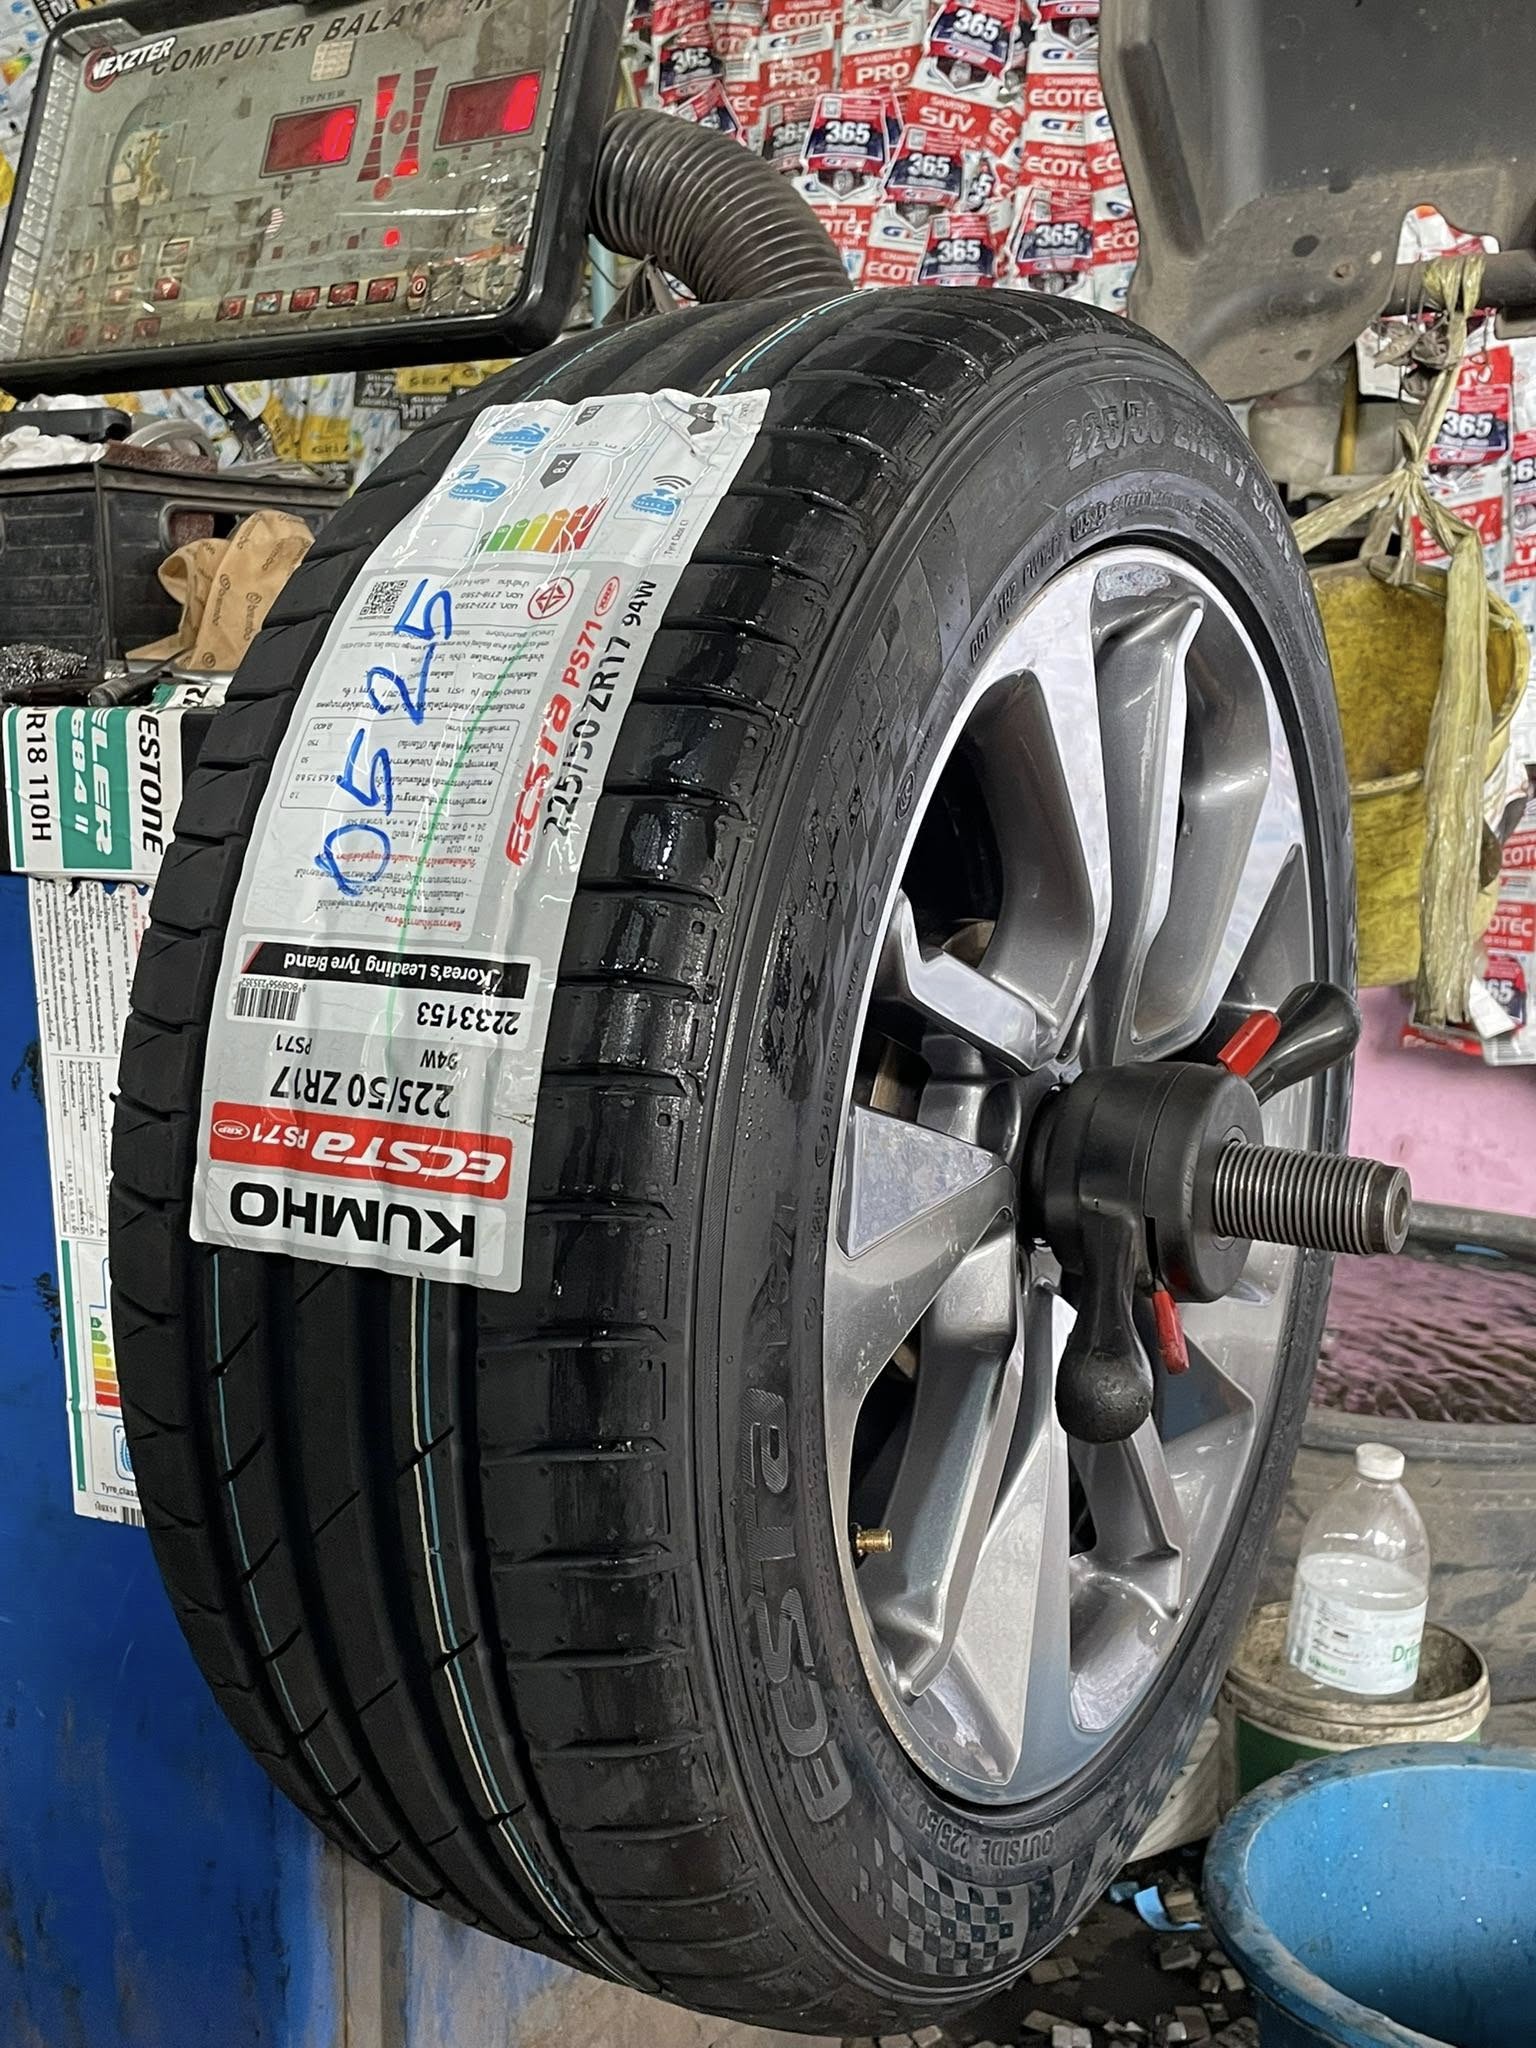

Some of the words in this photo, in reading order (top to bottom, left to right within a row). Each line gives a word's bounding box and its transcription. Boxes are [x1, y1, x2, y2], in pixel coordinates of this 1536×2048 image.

[953, 7, 1001, 42] 365
[91, 35, 177, 81] NEXZTER
[152, 24, 314, 76] COMPUTER
[768, 67, 821, 88] PRO
[855, 61, 910, 84] PRO
[729, 95, 758, 111] EC
[825, 120, 871, 145] 365
[919, 105, 977, 132] SUV
[907, 152, 952, 178] 365
[1034, 222, 1079, 248] 365
[937, 239, 981, 263] 365
[1442, 409, 1494, 439] 365
[561, 619, 604, 689] PS71
[970, 616, 992, 665] DOT
[472, 672, 497, 681] KOREA
[542, 717, 601, 837] 225/50
[587, 635, 632, 713] ZR17
[621, 579, 658, 627] 94W
[26, 706, 48, 764] R18
[71, 708, 88, 805] 684
[138, 713, 164, 856] ESTONE
[28, 774, 53, 841] 110H
[283, 951, 328, 973] Brand
[330, 953, 362, 975] Tyre
[364, 955, 427, 981] Leading
[430, 963, 500, 988] Korea's
[416, 1001, 522, 1037] 2233153
[275, 1033, 313, 1056] PS71
[419, 1048, 459, 1071] 94W
[269, 1065, 342, 1106] ZR17
[346, 1072, 455, 1119] 225/50
[217, 1124, 245, 1136] XRP
[250, 1121, 310, 1150] PS71
[229, 1181, 477, 1258] KUMHO
[101, 1482, 118, 1495] Tyre
[916, 1802, 972, 1859] 225/50
[980, 1829, 1056, 1866] OUTSIDE
